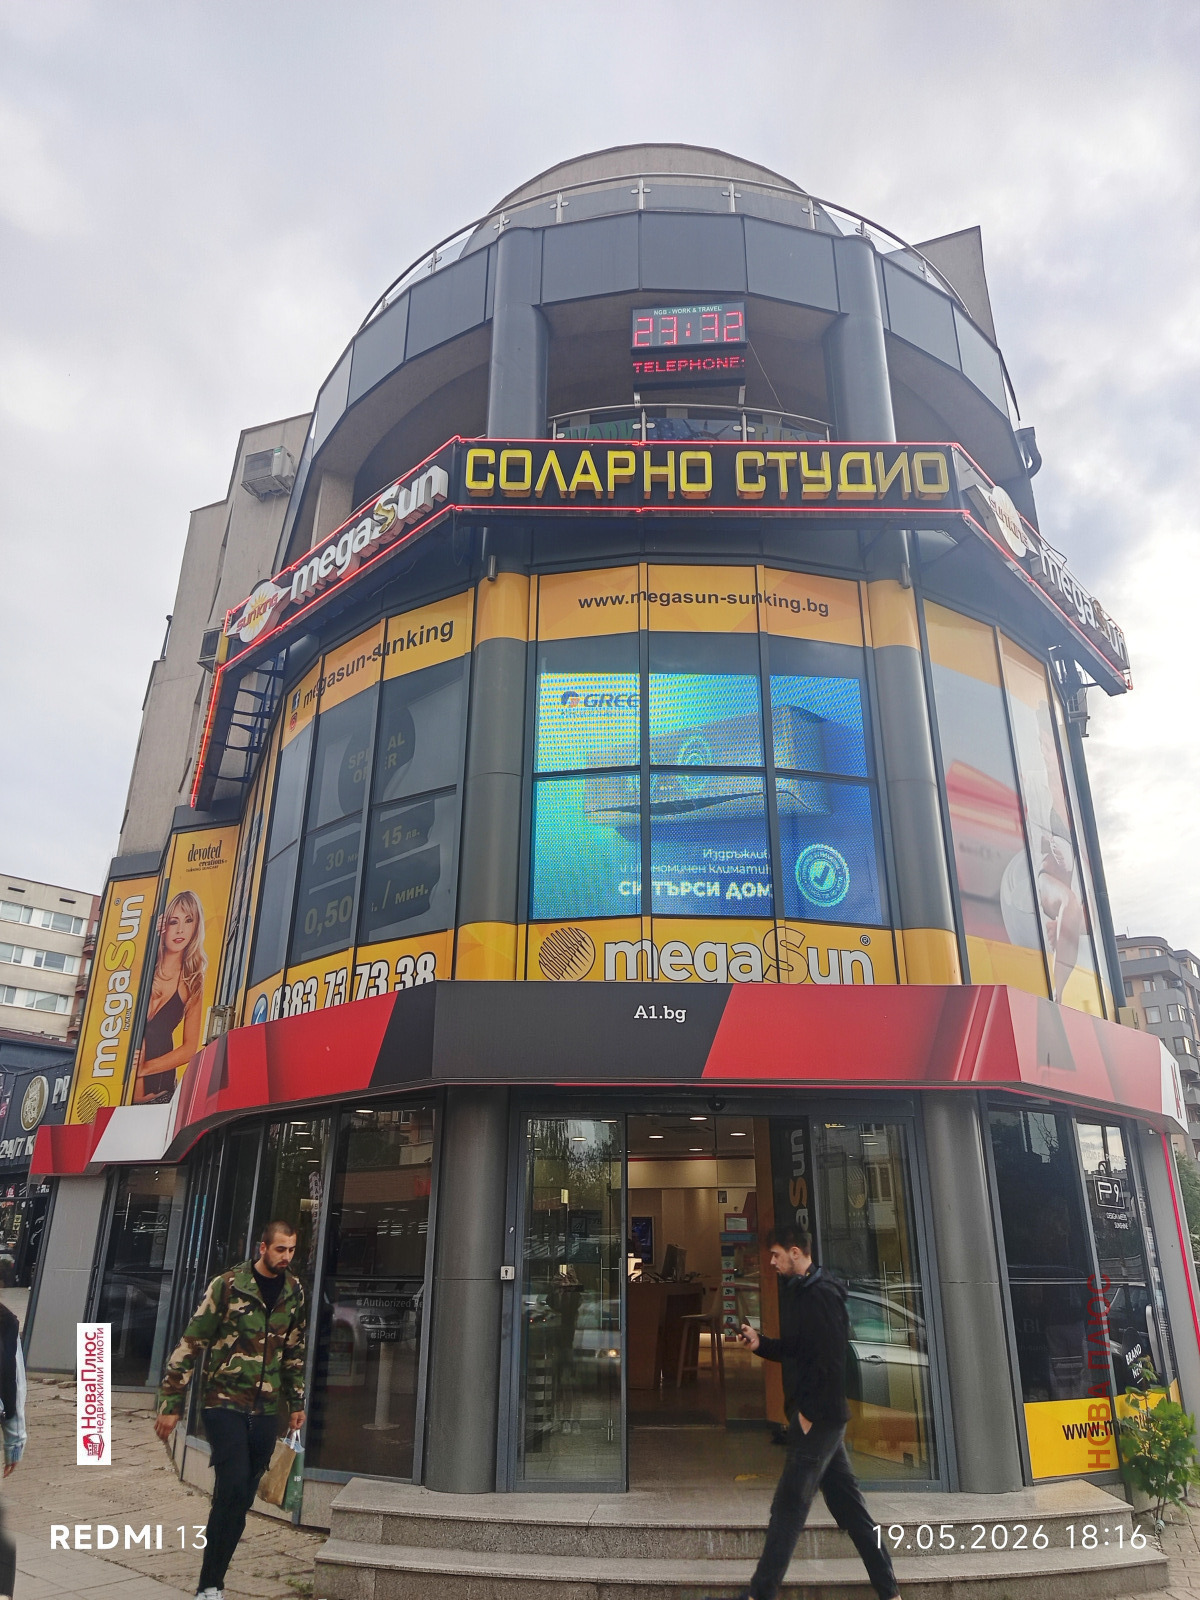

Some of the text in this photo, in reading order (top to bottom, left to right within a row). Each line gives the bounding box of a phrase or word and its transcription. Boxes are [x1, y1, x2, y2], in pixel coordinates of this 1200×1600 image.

[634, 311, 743, 347] 23:32
[464, 448, 952, 499] СОЛАРНО СТУДИО
[290, 465, 448, 603] megaSun
[578, 589, 830, 617] www.megasun-sunking.bg
[188, 840, 223, 862] devoted
[325, 848, 344, 871] 30
[382, 825, 403, 848] 15
[304, 895, 353, 937] 0,50
[604, 926, 875, 984] megaSun
[91, 895, 144, 1079] megaSun
[354, 959, 389, 1002] 73
[394, 951, 436, 992] 38
[633, 1004, 687, 1023] A1.bg
[363, 1297, 411, 1308] Authorized
[377, 1330, 397, 1339] iPad
